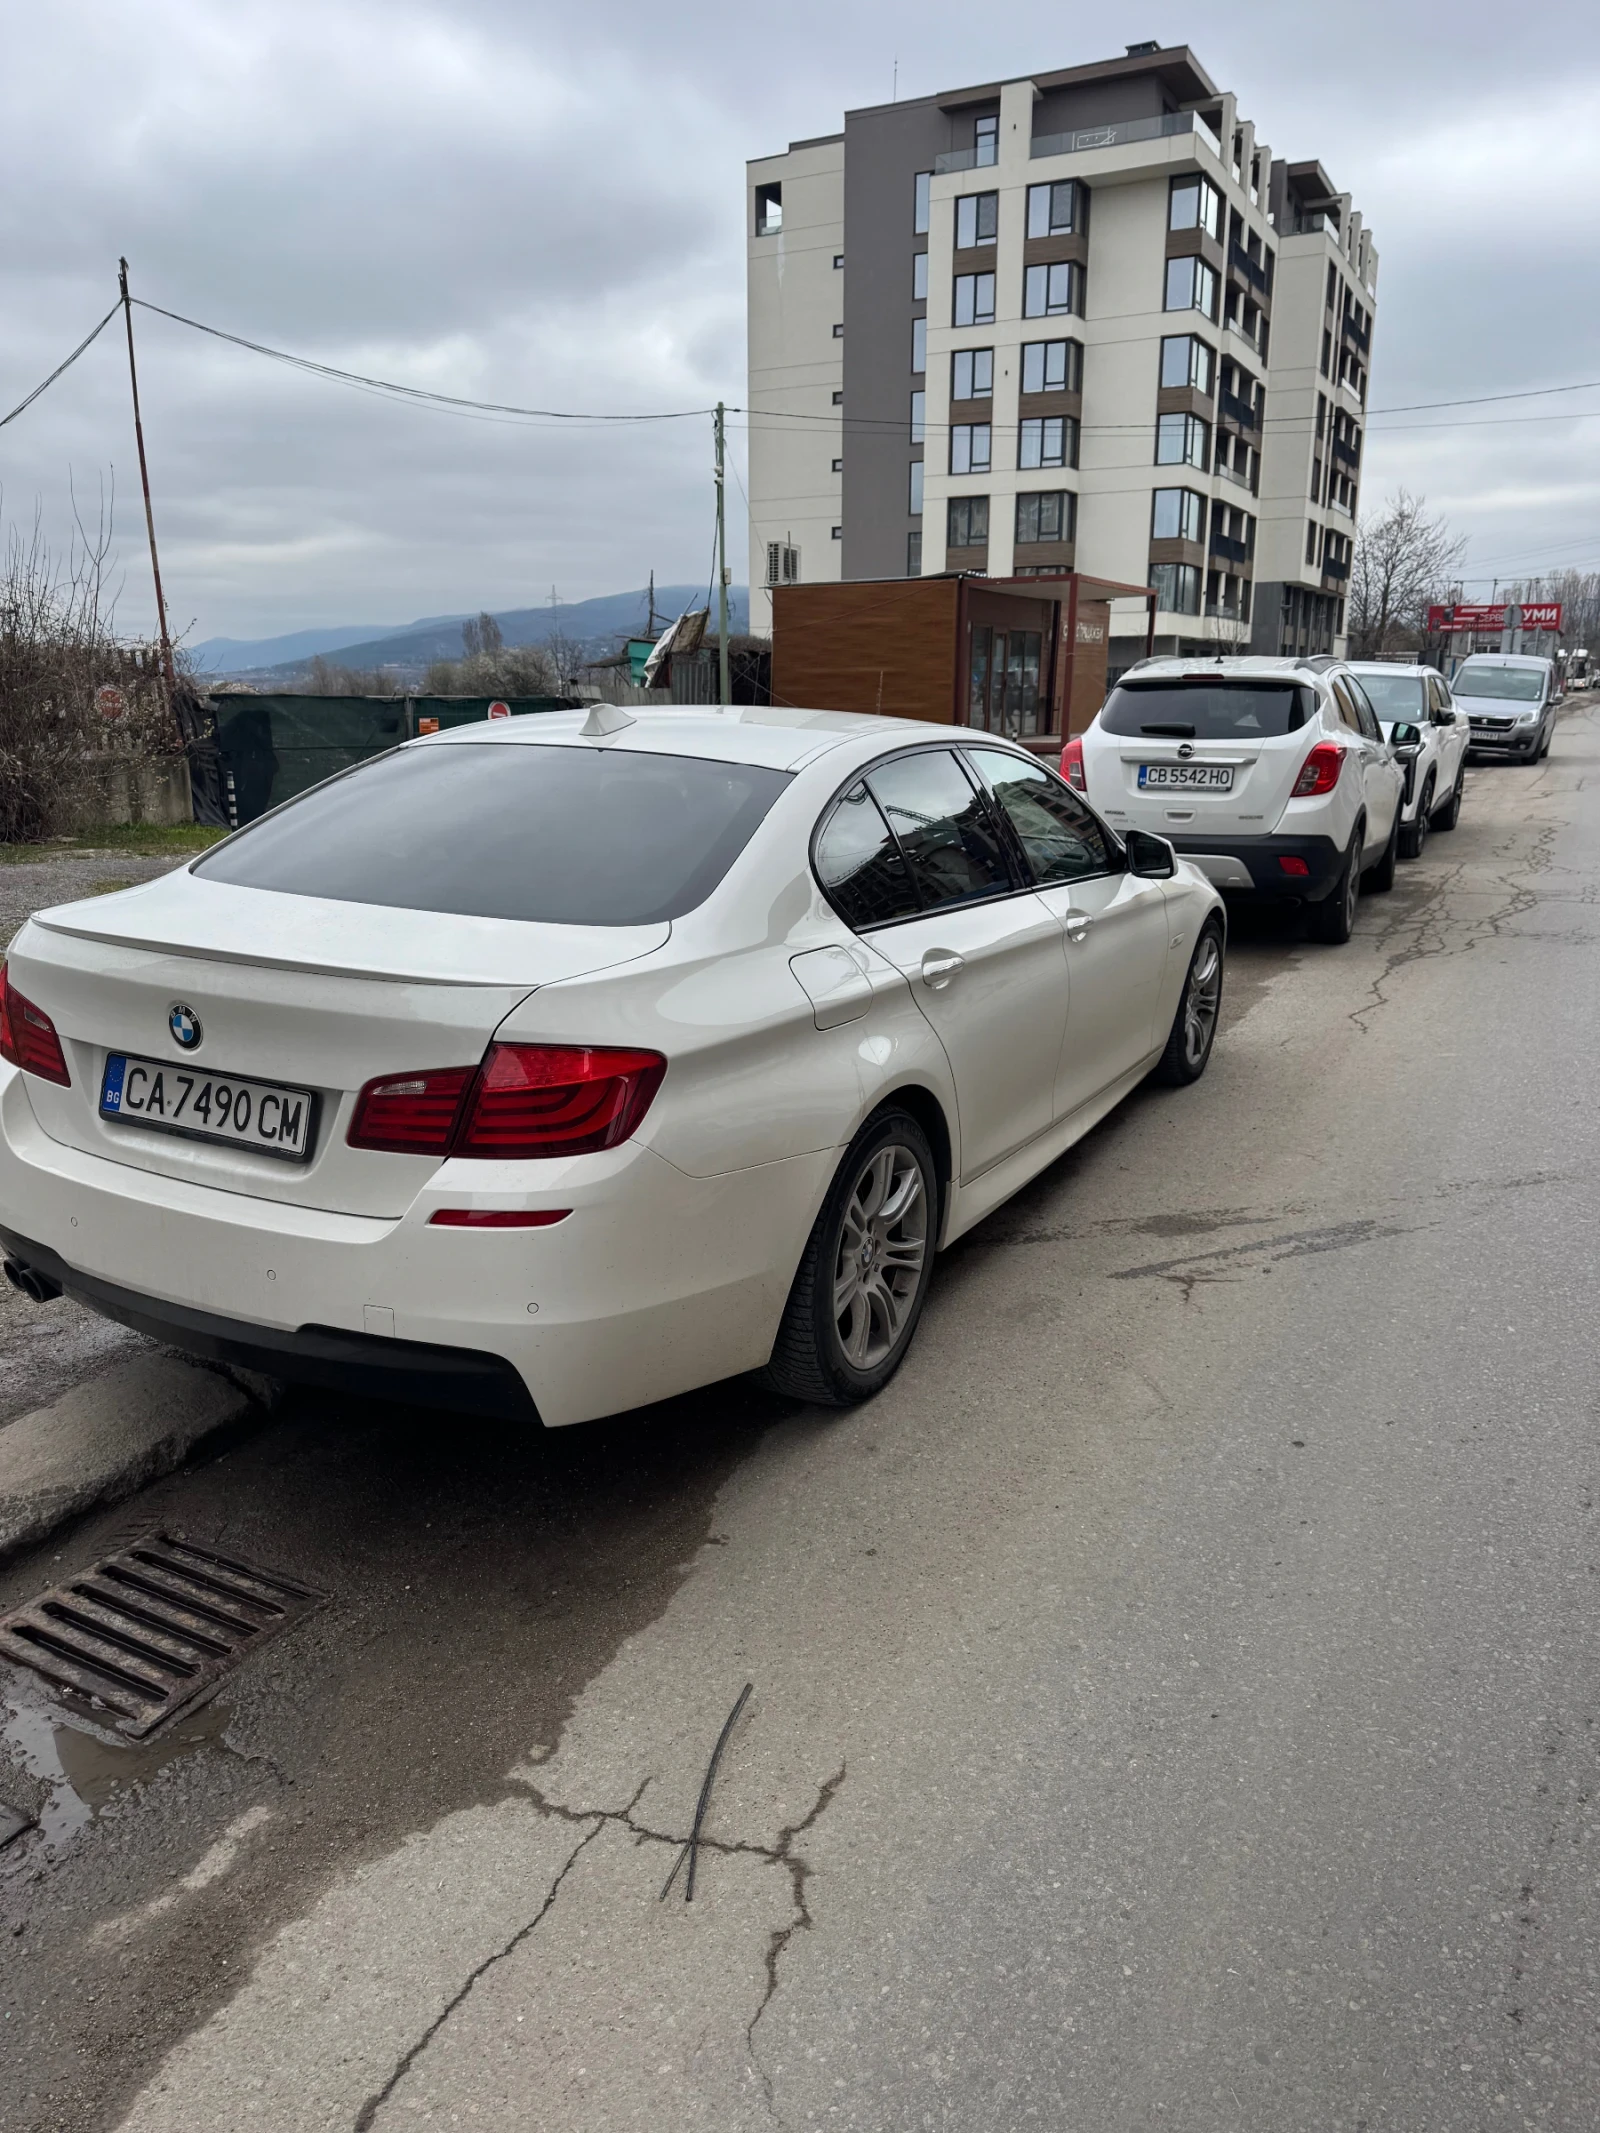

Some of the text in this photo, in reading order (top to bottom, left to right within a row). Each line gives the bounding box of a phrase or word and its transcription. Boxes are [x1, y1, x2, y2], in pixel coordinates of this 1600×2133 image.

[1522, 608, 1558, 621] УМИ
[1148, 768, 1230, 785] CB 5542 HO
[171, 1006, 198, 1022] BMW
[106, 1089, 120, 1104] BG
[125, 1067, 303, 1145] CA 7490 CM
